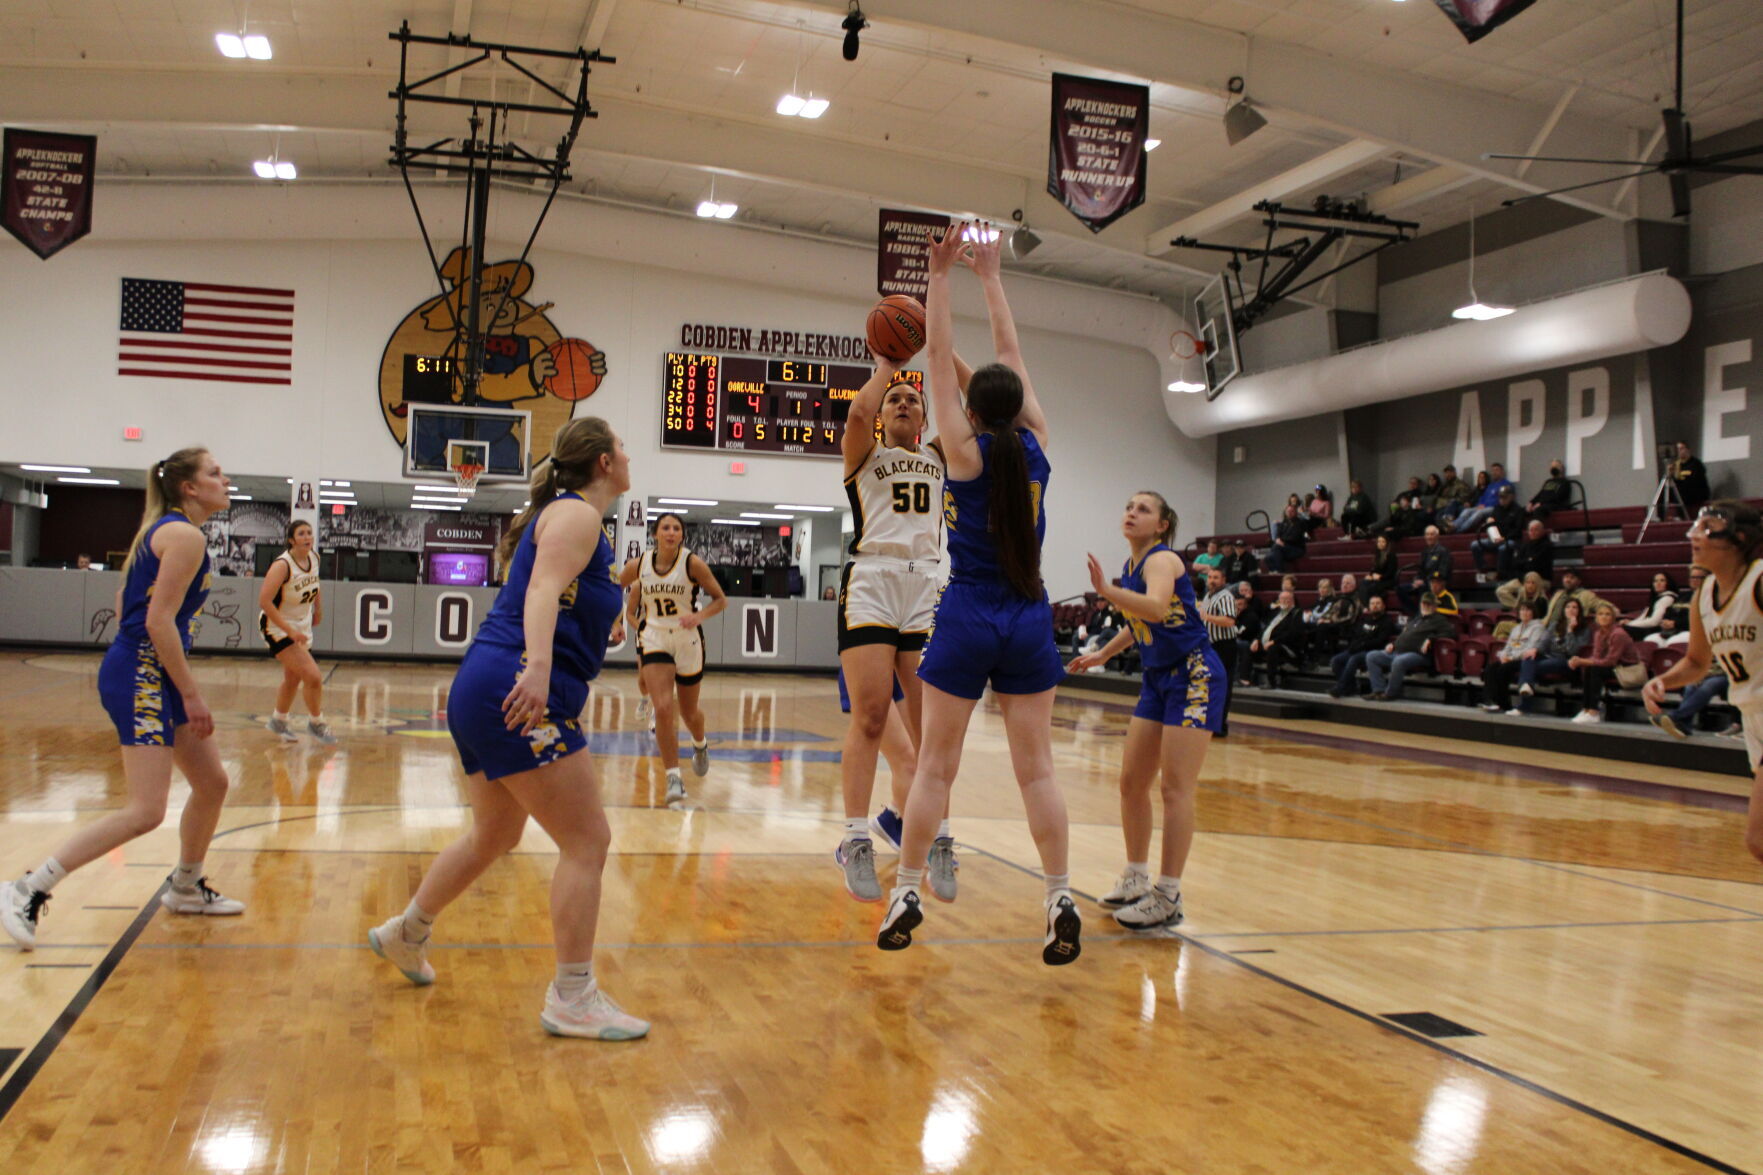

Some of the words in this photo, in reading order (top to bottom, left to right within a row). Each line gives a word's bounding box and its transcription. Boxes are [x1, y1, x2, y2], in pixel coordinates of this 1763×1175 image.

[1064, 98, 1138, 118] APPLEKNOCKERS
[1068, 124, 1134, 144] 2015-16
[16, 147, 84, 164] APPLEKNOCKERS
[1077, 142, 1120, 157] 20-6-1
[1076, 155, 1118, 170] STATE
[16, 169, 84, 184] 2007-08
[1060, 168, 1114, 186] RUNNER
[1114, 176, 1135, 188] UP
[26, 196, 68, 208] STATE
[20, 208, 74, 221] CHAMPS
[884, 221, 946, 238] APPLEKNOCKERS
[894, 268, 930, 282] STATE
[882, 280, 928, 294] RUNNER
[682, 324, 752, 350] COBDEN
[416, 358, 449, 372] 6:11
[668, 352, 684, 364] PLY
[700, 356, 717, 367] PTS
[672, 364, 684, 376] 10
[688, 366, 696, 378] 0
[708, 366, 716, 379] 0
[782, 362, 824, 382] 6:11
[672, 378, 684, 390] 12
[688, 378, 696, 391] 0
[708, 380, 714, 392] 0
[668, 390, 682, 404] 22
[687, 392, 694, 404] 0
[707, 394, 714, 406] 0
[786, 390, 808, 400] PERIOD
[668, 404, 682, 416] 34
[687, 405, 694, 418] 0
[706, 406, 714, 419] 0
[748, 395, 760, 414] 4
[796, 400, 800, 414] 1
[666, 418, 682, 430] 50
[686, 418, 694, 431] 0
[706, 420, 714, 431] 4
[726, 415, 746, 424] FOULS
[776, 418, 798, 427] PLAYER
[800, 420, 815, 428] FOUL
[733, 422, 743, 438] 0
[756, 424, 765, 440] 5
[824, 430, 834, 443] 4
[725, 441, 744, 450] SCORE
[784, 444, 804, 454] MATCH
[874, 460, 941, 480] BLACKCATS
[892, 482, 930, 514] 50
[436, 528, 482, 540] COBDEN
[654, 598, 678, 617] 12
